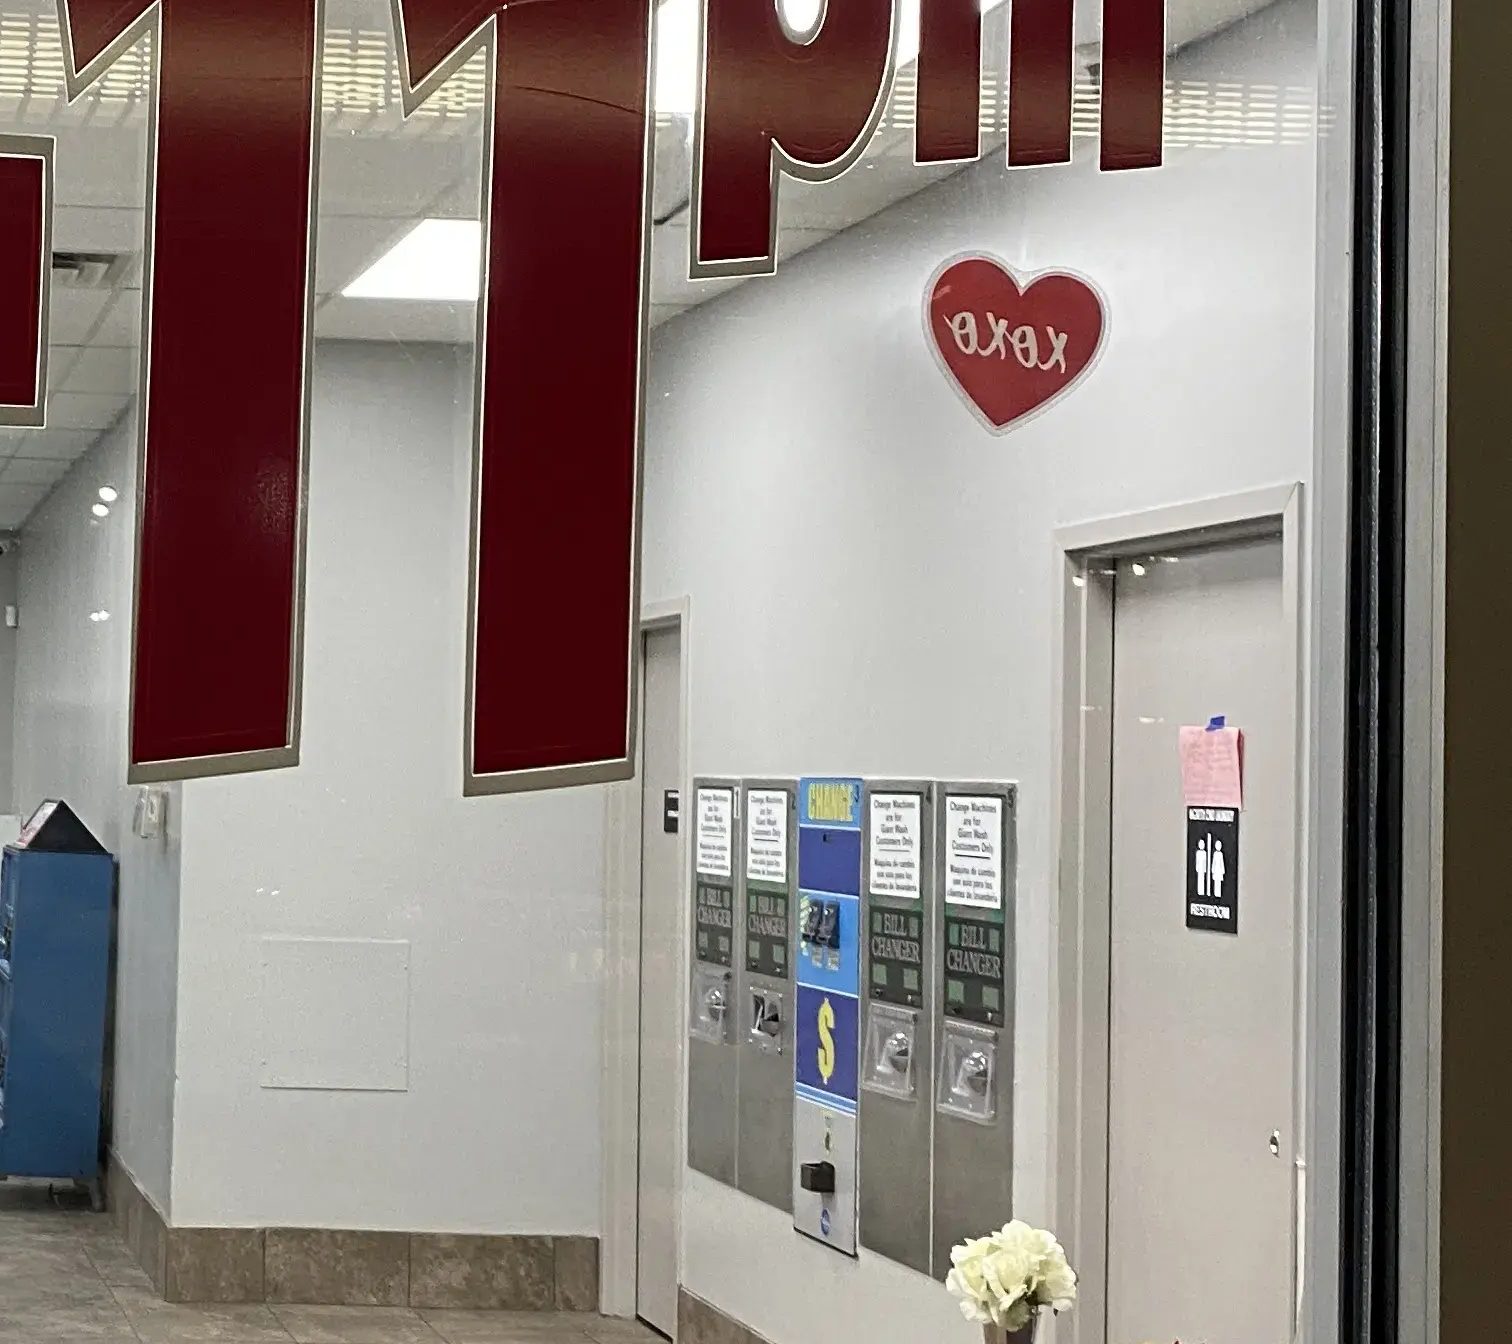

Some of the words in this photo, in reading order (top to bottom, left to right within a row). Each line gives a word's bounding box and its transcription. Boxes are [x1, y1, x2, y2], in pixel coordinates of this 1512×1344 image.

[883, 913, 907, 936] BILL
[961, 924, 986, 949] BILL
[871, 936, 920, 964] CHANGER
[947, 948, 1001, 979] CHANGER
